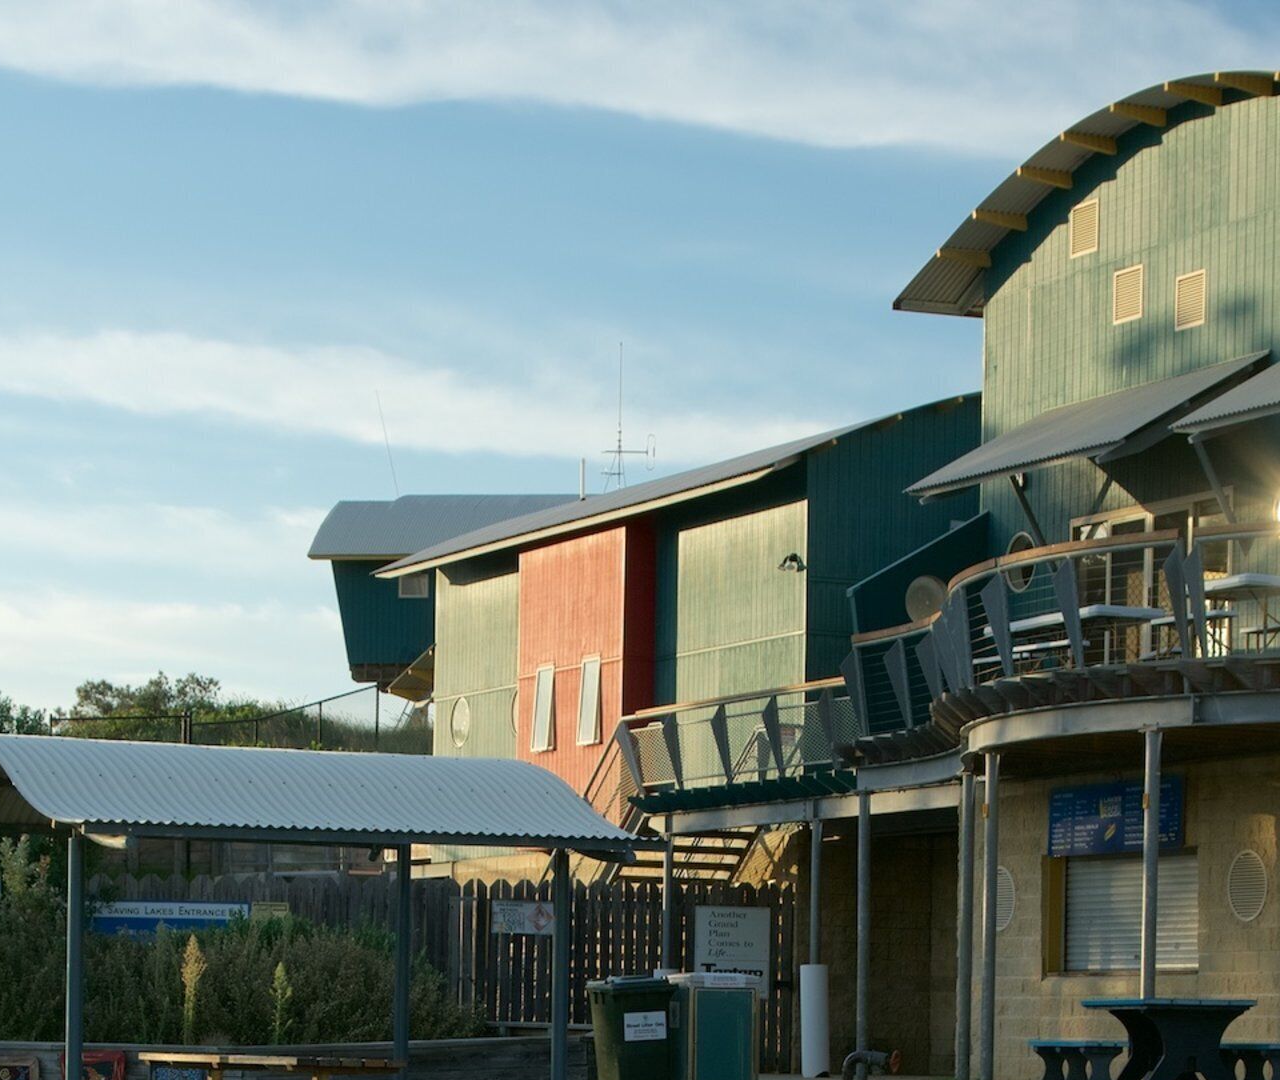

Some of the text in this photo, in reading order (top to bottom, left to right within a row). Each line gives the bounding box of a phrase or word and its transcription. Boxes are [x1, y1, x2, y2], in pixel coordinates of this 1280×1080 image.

[709, 911, 747, 919] Another
[708, 920, 738, 928] Grand
[708, 939, 740, 947] Comes
